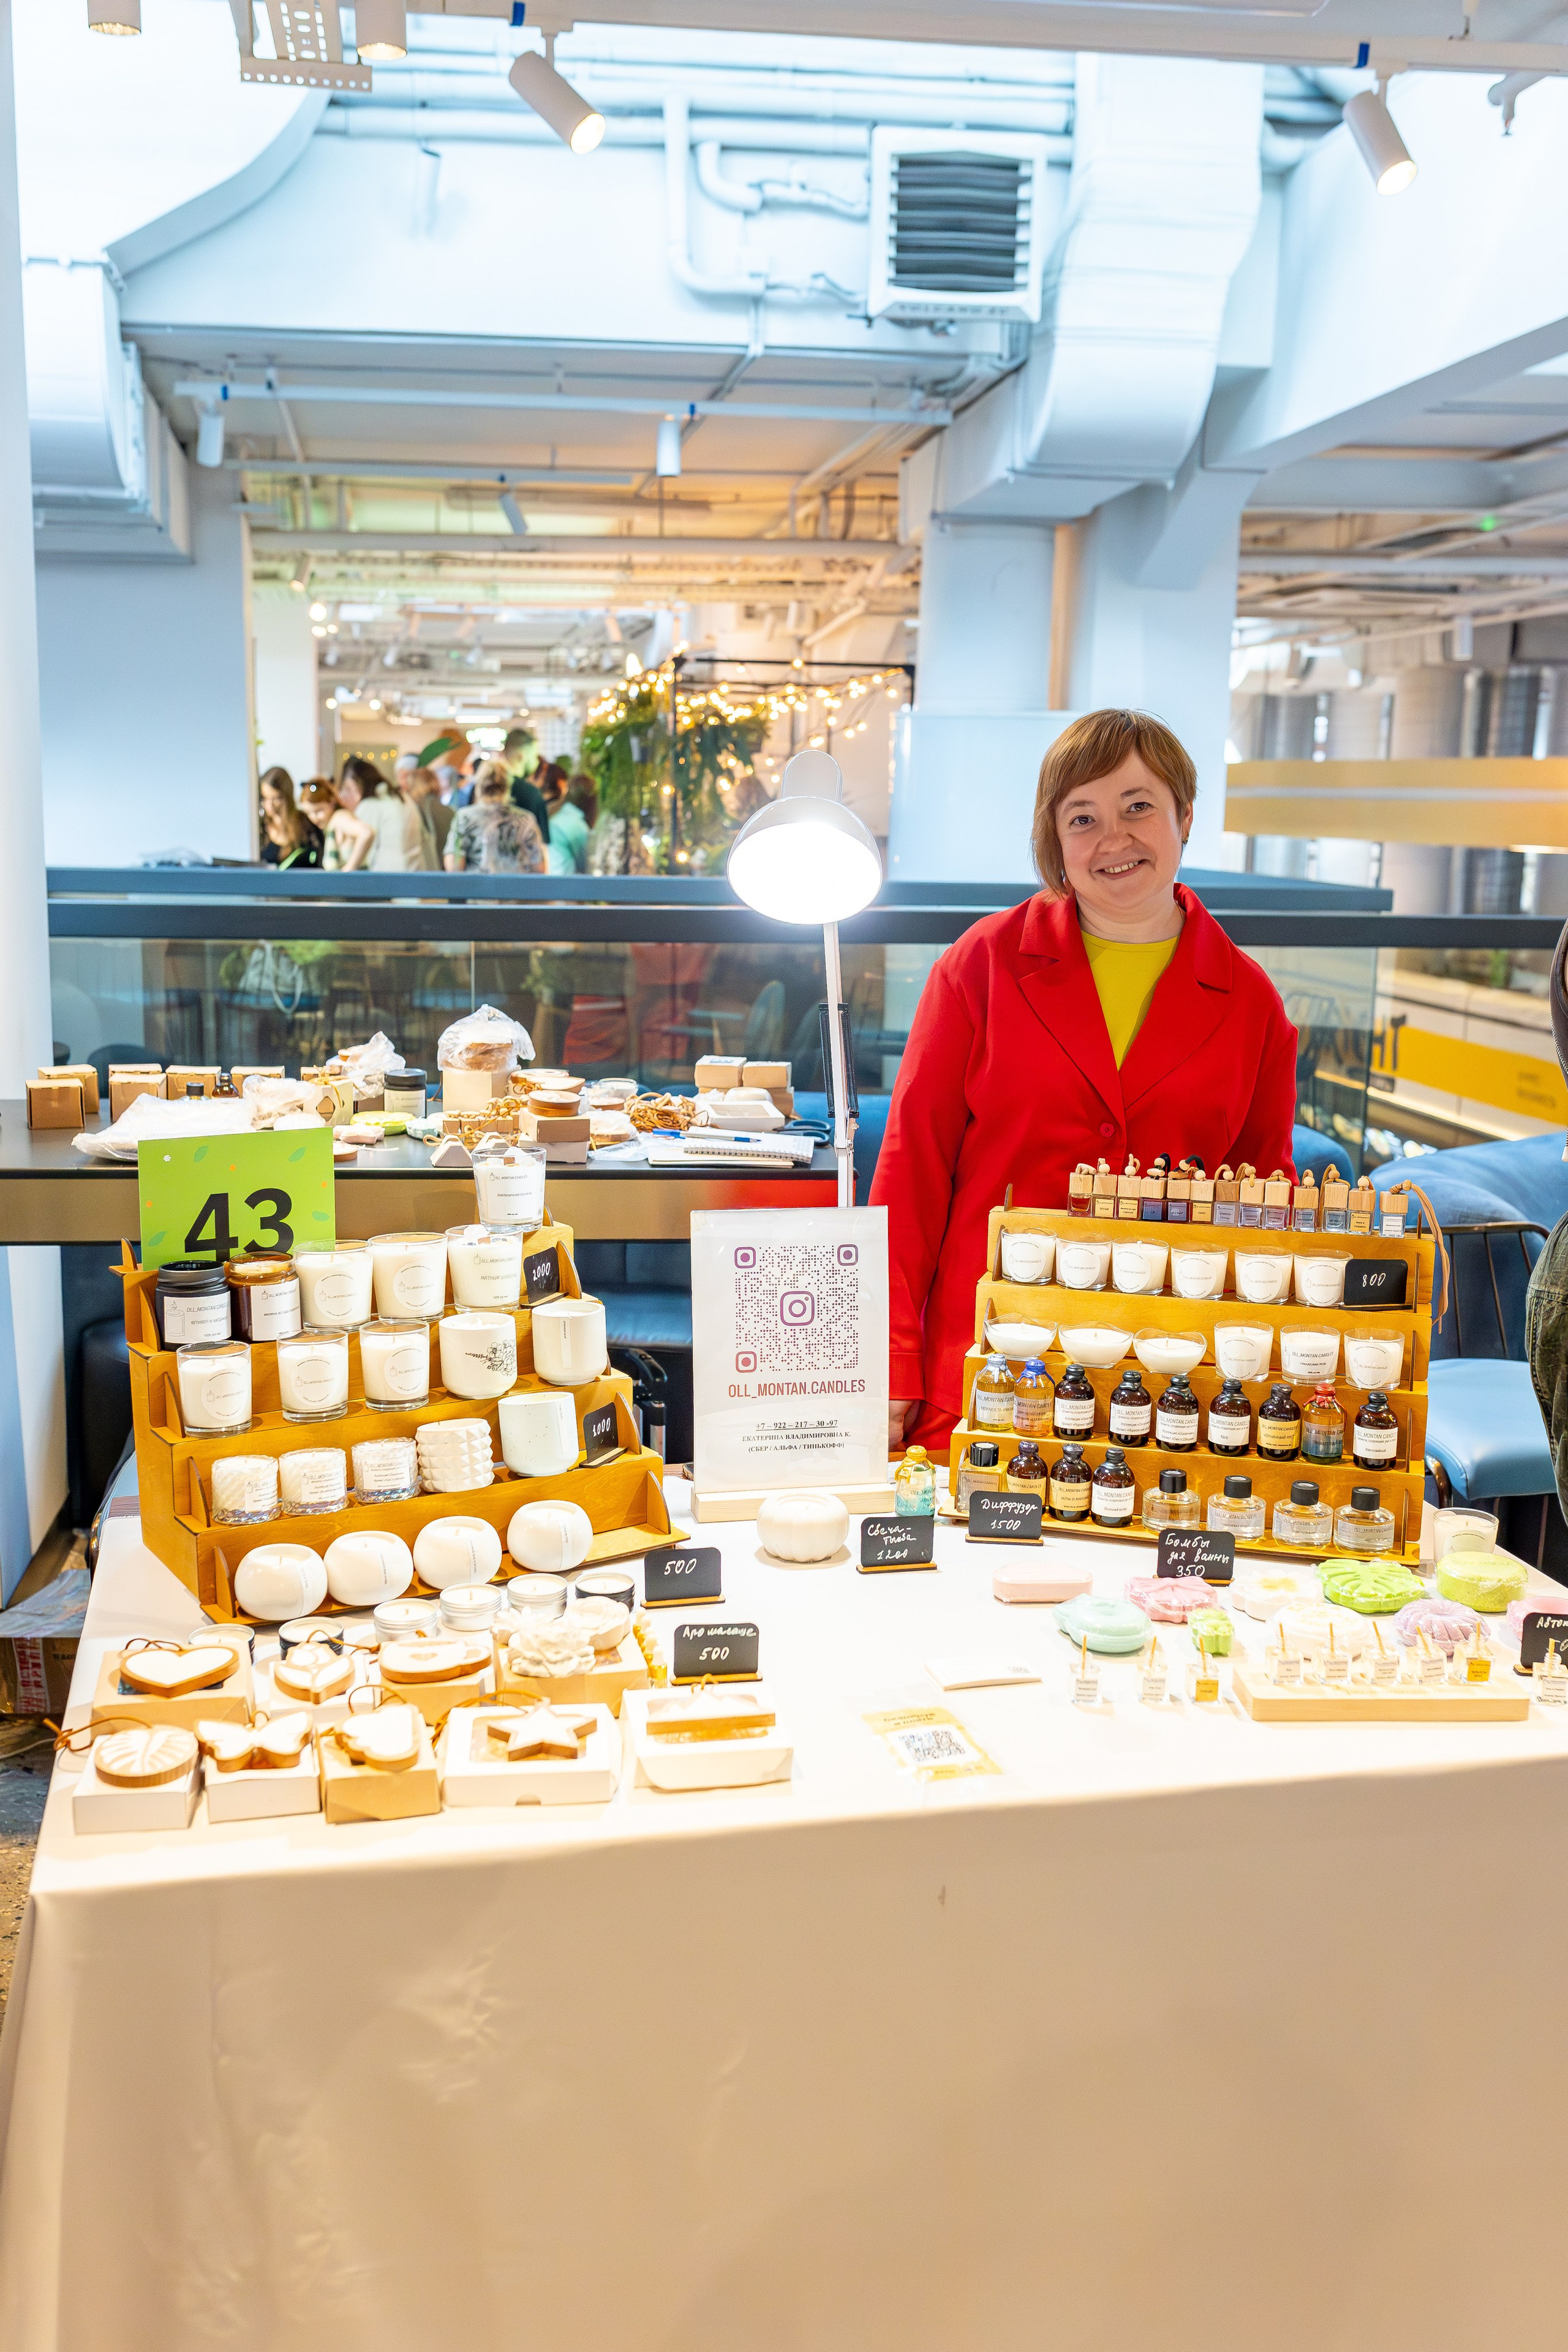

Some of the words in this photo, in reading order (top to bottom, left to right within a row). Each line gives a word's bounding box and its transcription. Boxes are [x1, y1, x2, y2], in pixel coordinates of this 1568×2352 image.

[184, 1188, 295, 1262] 43
[532, 1262, 551, 1281] 2000
[1362, 1273, 1386, 1287] 800
[728, 1379, 865, 1399] OLL_MONTAN.CANDLES
[592, 1417, 611, 1437] 1000
[981, 1498, 1038, 1515] Диффузор
[990, 1520, 1021, 1531] 1500
[1166, 1532, 1210, 1548] Бомбы
[876, 1548, 908, 1561] 1200
[1167, 1548, 1186, 1563] для
[1194, 1548, 1230, 1563] ванны
[663, 1558, 697, 1575] 500
[1175, 1564, 1205, 1578] 350
[699, 1646, 729, 1660] 500
